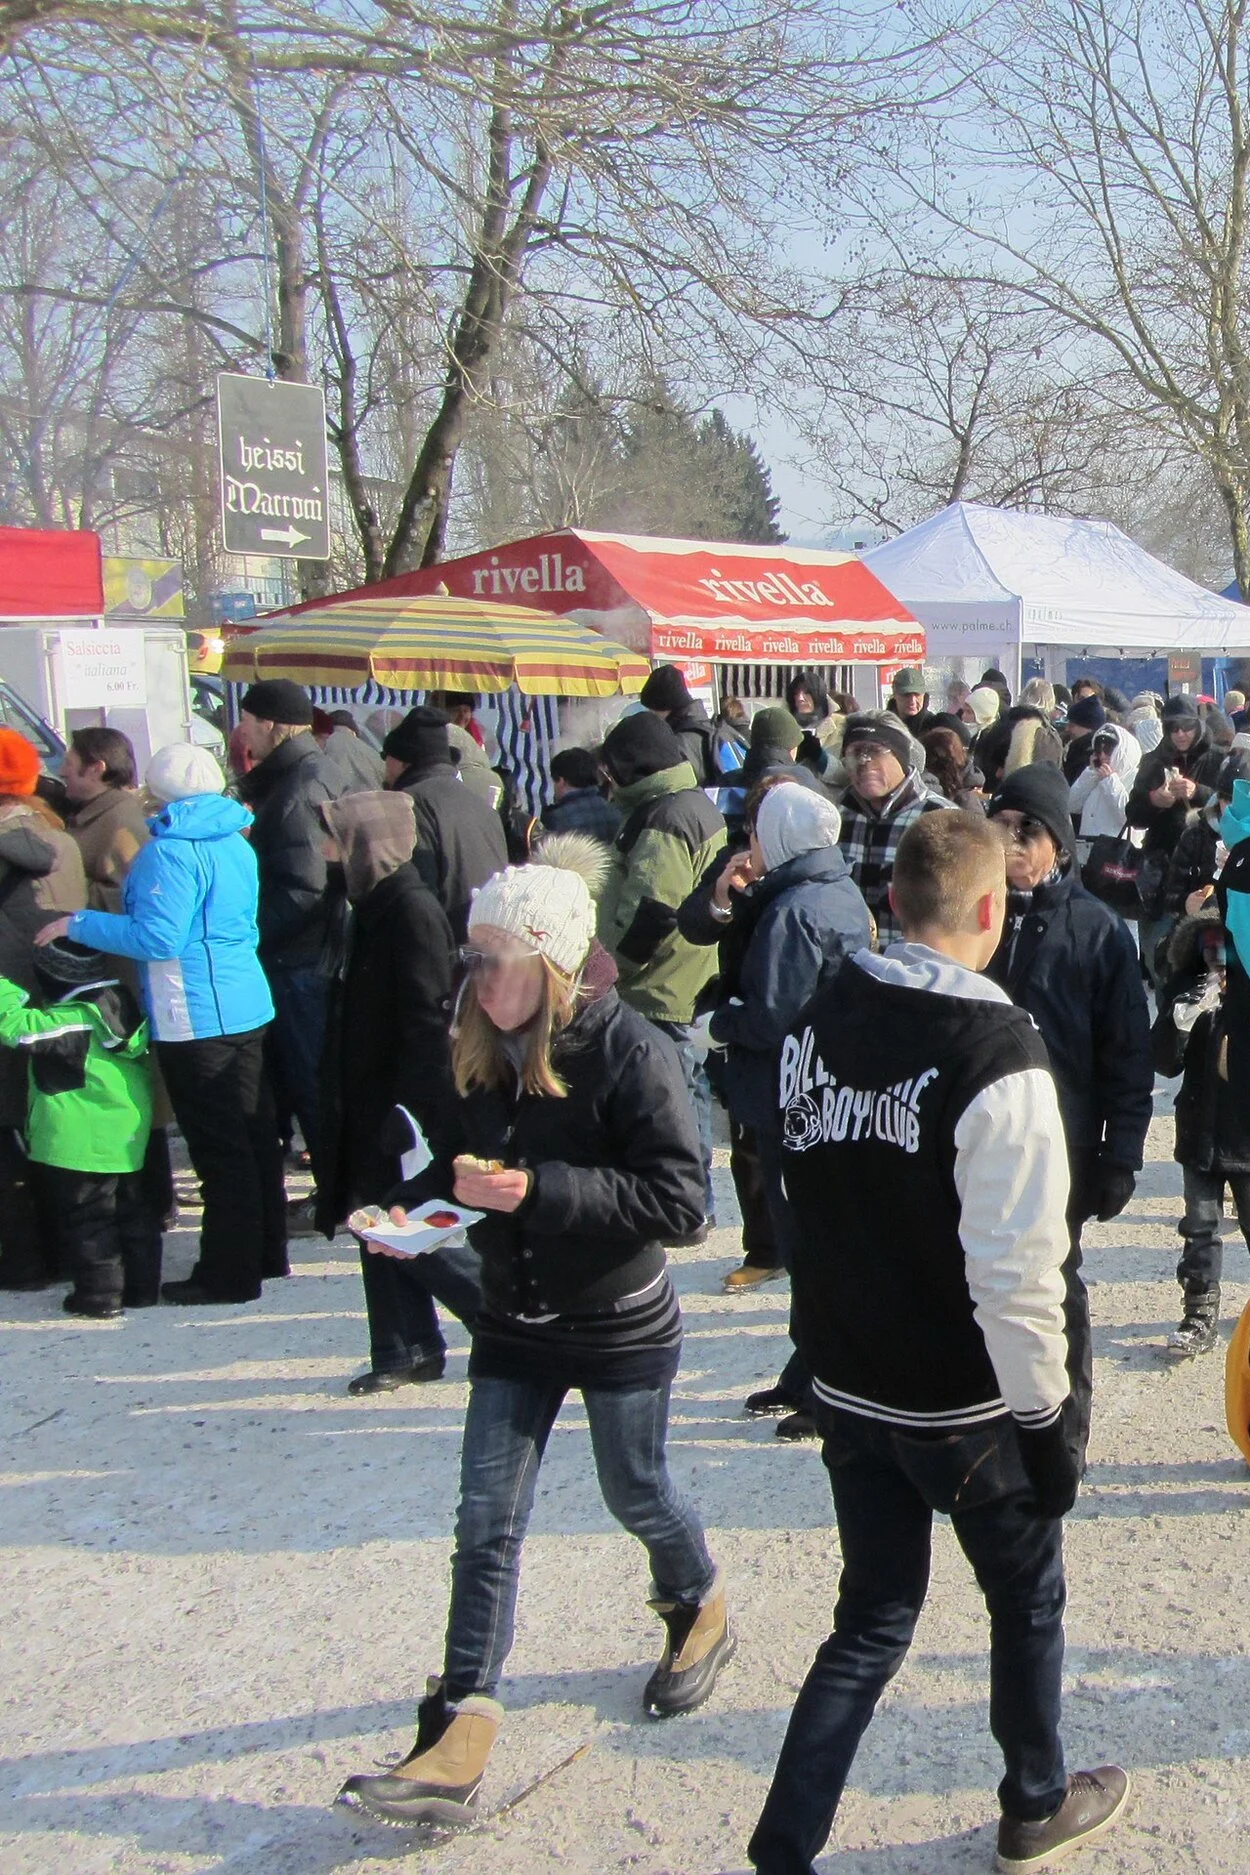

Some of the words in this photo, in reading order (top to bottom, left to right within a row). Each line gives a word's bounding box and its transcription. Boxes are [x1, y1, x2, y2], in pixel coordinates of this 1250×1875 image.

[240, 436, 304, 474] heissi
[472, 553, 586, 594] rivella
[698, 568, 835, 607] rivella
[931, 619, 1011, 634] www.palme.ch
[67, 640, 121, 656] Salsiccia
[658, 631, 703, 649] rivella
[715, 634, 752, 652] rivella
[762, 637, 799, 653] rivella
[808, 639, 844, 654] rivella
[853, 640, 885, 654] rivella
[894, 639, 923, 654] rivella
[106, 682, 125, 691] 6.00
[127, 681, 140, 691] Fr.
[876, 1093, 920, 1153] CLUB
